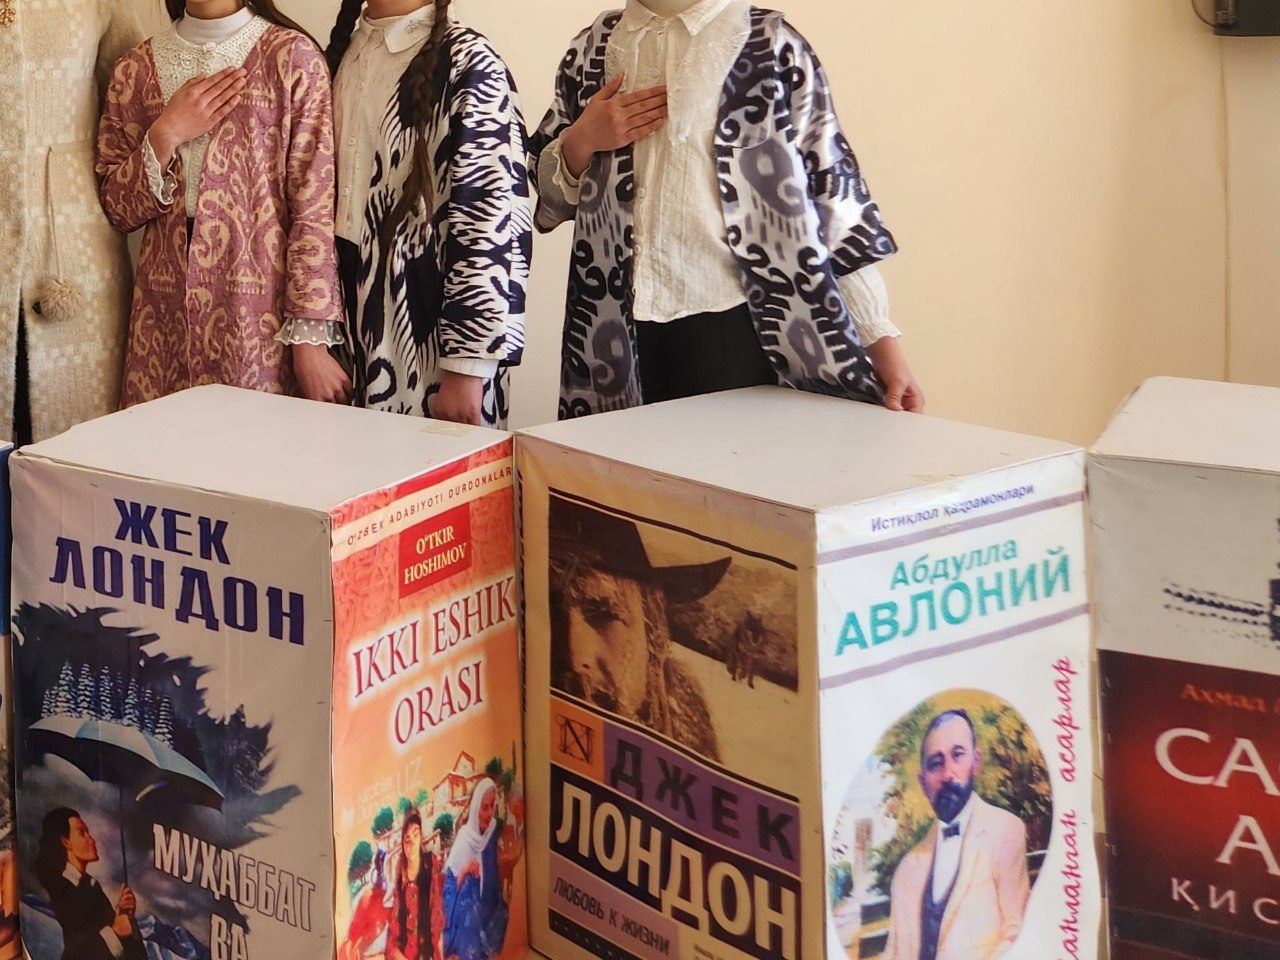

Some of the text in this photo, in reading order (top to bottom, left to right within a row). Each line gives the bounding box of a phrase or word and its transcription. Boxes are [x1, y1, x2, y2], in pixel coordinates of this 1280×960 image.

[113, 498, 231, 565] ЖЕК
[389, 494, 443, 525] ADABIYOTI
[448, 465, 512, 499] DURDONALAR
[871, 507, 939, 532] Истиқлол
[49, 536, 305, 646] ЛОНДОН
[404, 542, 467, 585] HOSHIMOV
[834, 546, 1071, 657] АВЛОНИЙ
[889, 539, 1018, 591] Абдулла
[352, 576, 516, 699] IKKI ESHIK
[394, 660, 484, 745] ORASI
[610, 738, 795, 862] ДЖЕК
[1155, 726, 1280, 797] СА
[152, 822, 316, 932] МУҲАББАТ
[556, 781, 796, 960] ЛОНДОН
[210, 913, 250, 960] ВА
[553, 876, 670, 957] ЛЮБОВЬ К ЖИЗНИ
